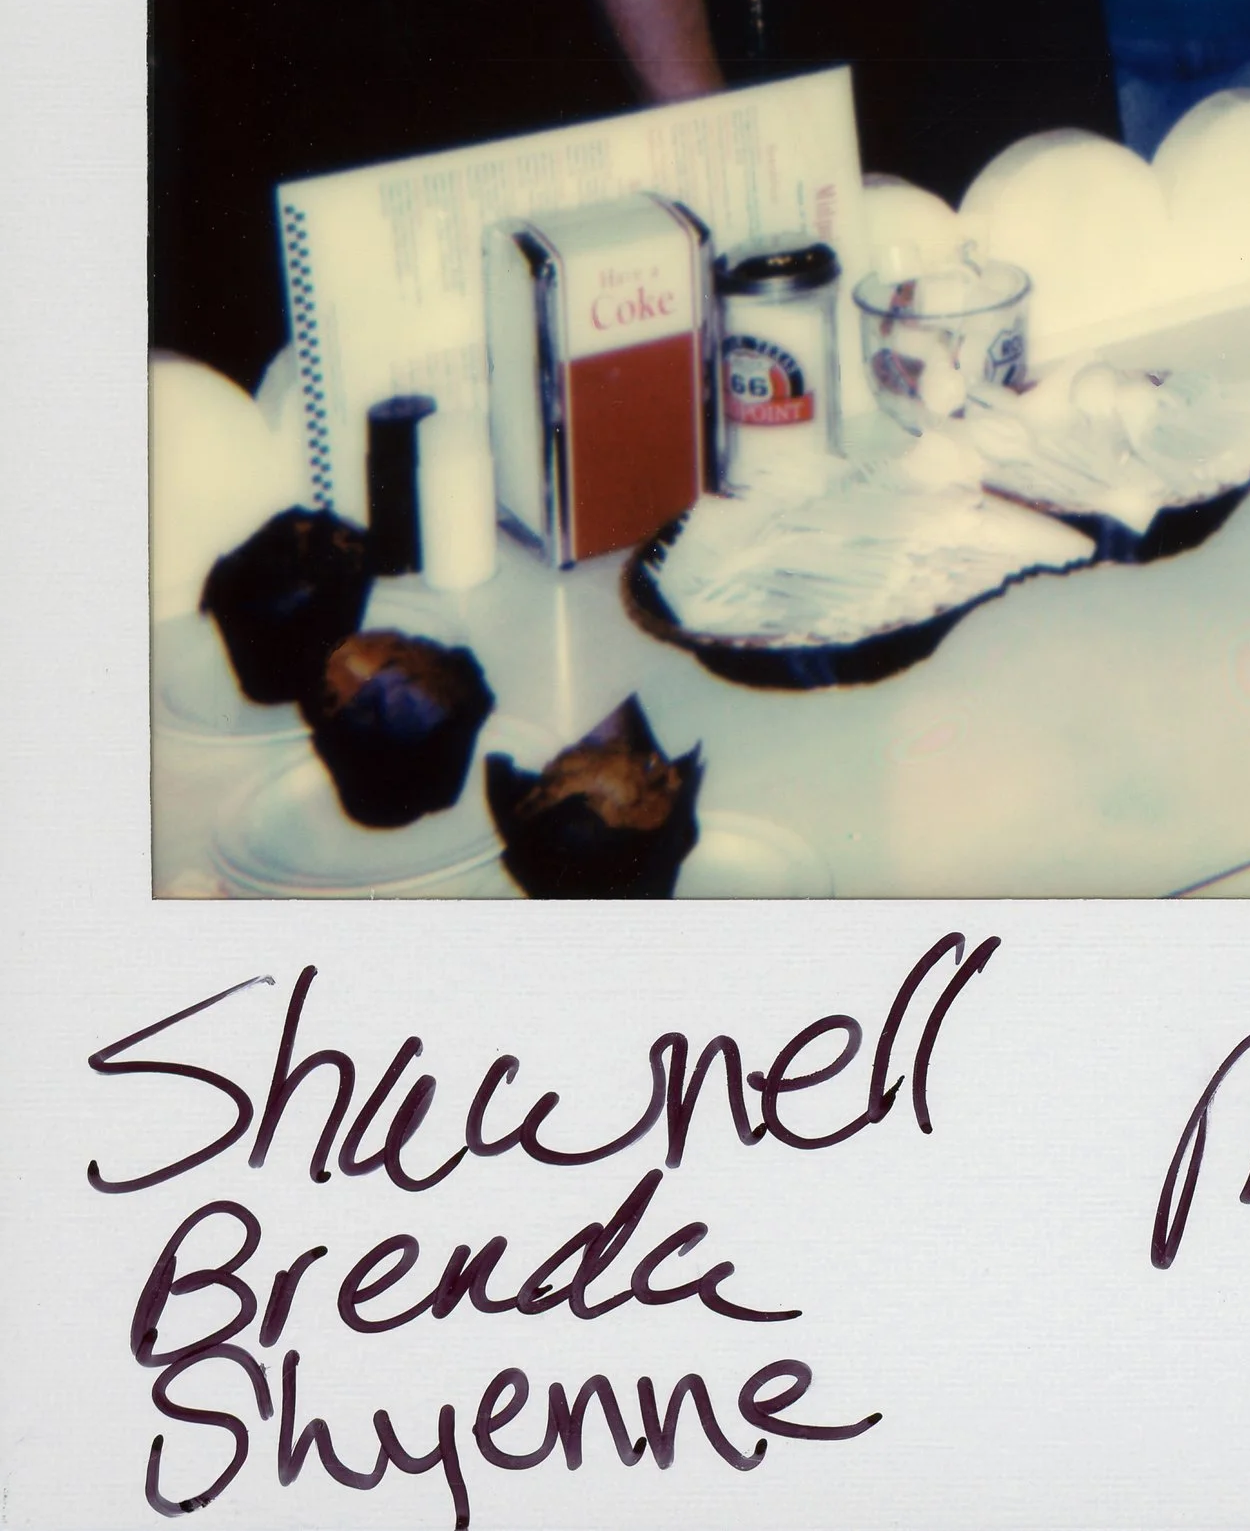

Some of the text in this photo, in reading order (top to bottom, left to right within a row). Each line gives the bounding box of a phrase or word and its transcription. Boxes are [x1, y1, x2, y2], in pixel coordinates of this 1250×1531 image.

[590, 286, 677, 331] Coke
[730, 372, 769, 398] 66
[87, 932, 1001, 1193] Shawnell
[131, 1168, 803, 1367] Brenda
[145, 1342, 884, 1530] Shyenne
